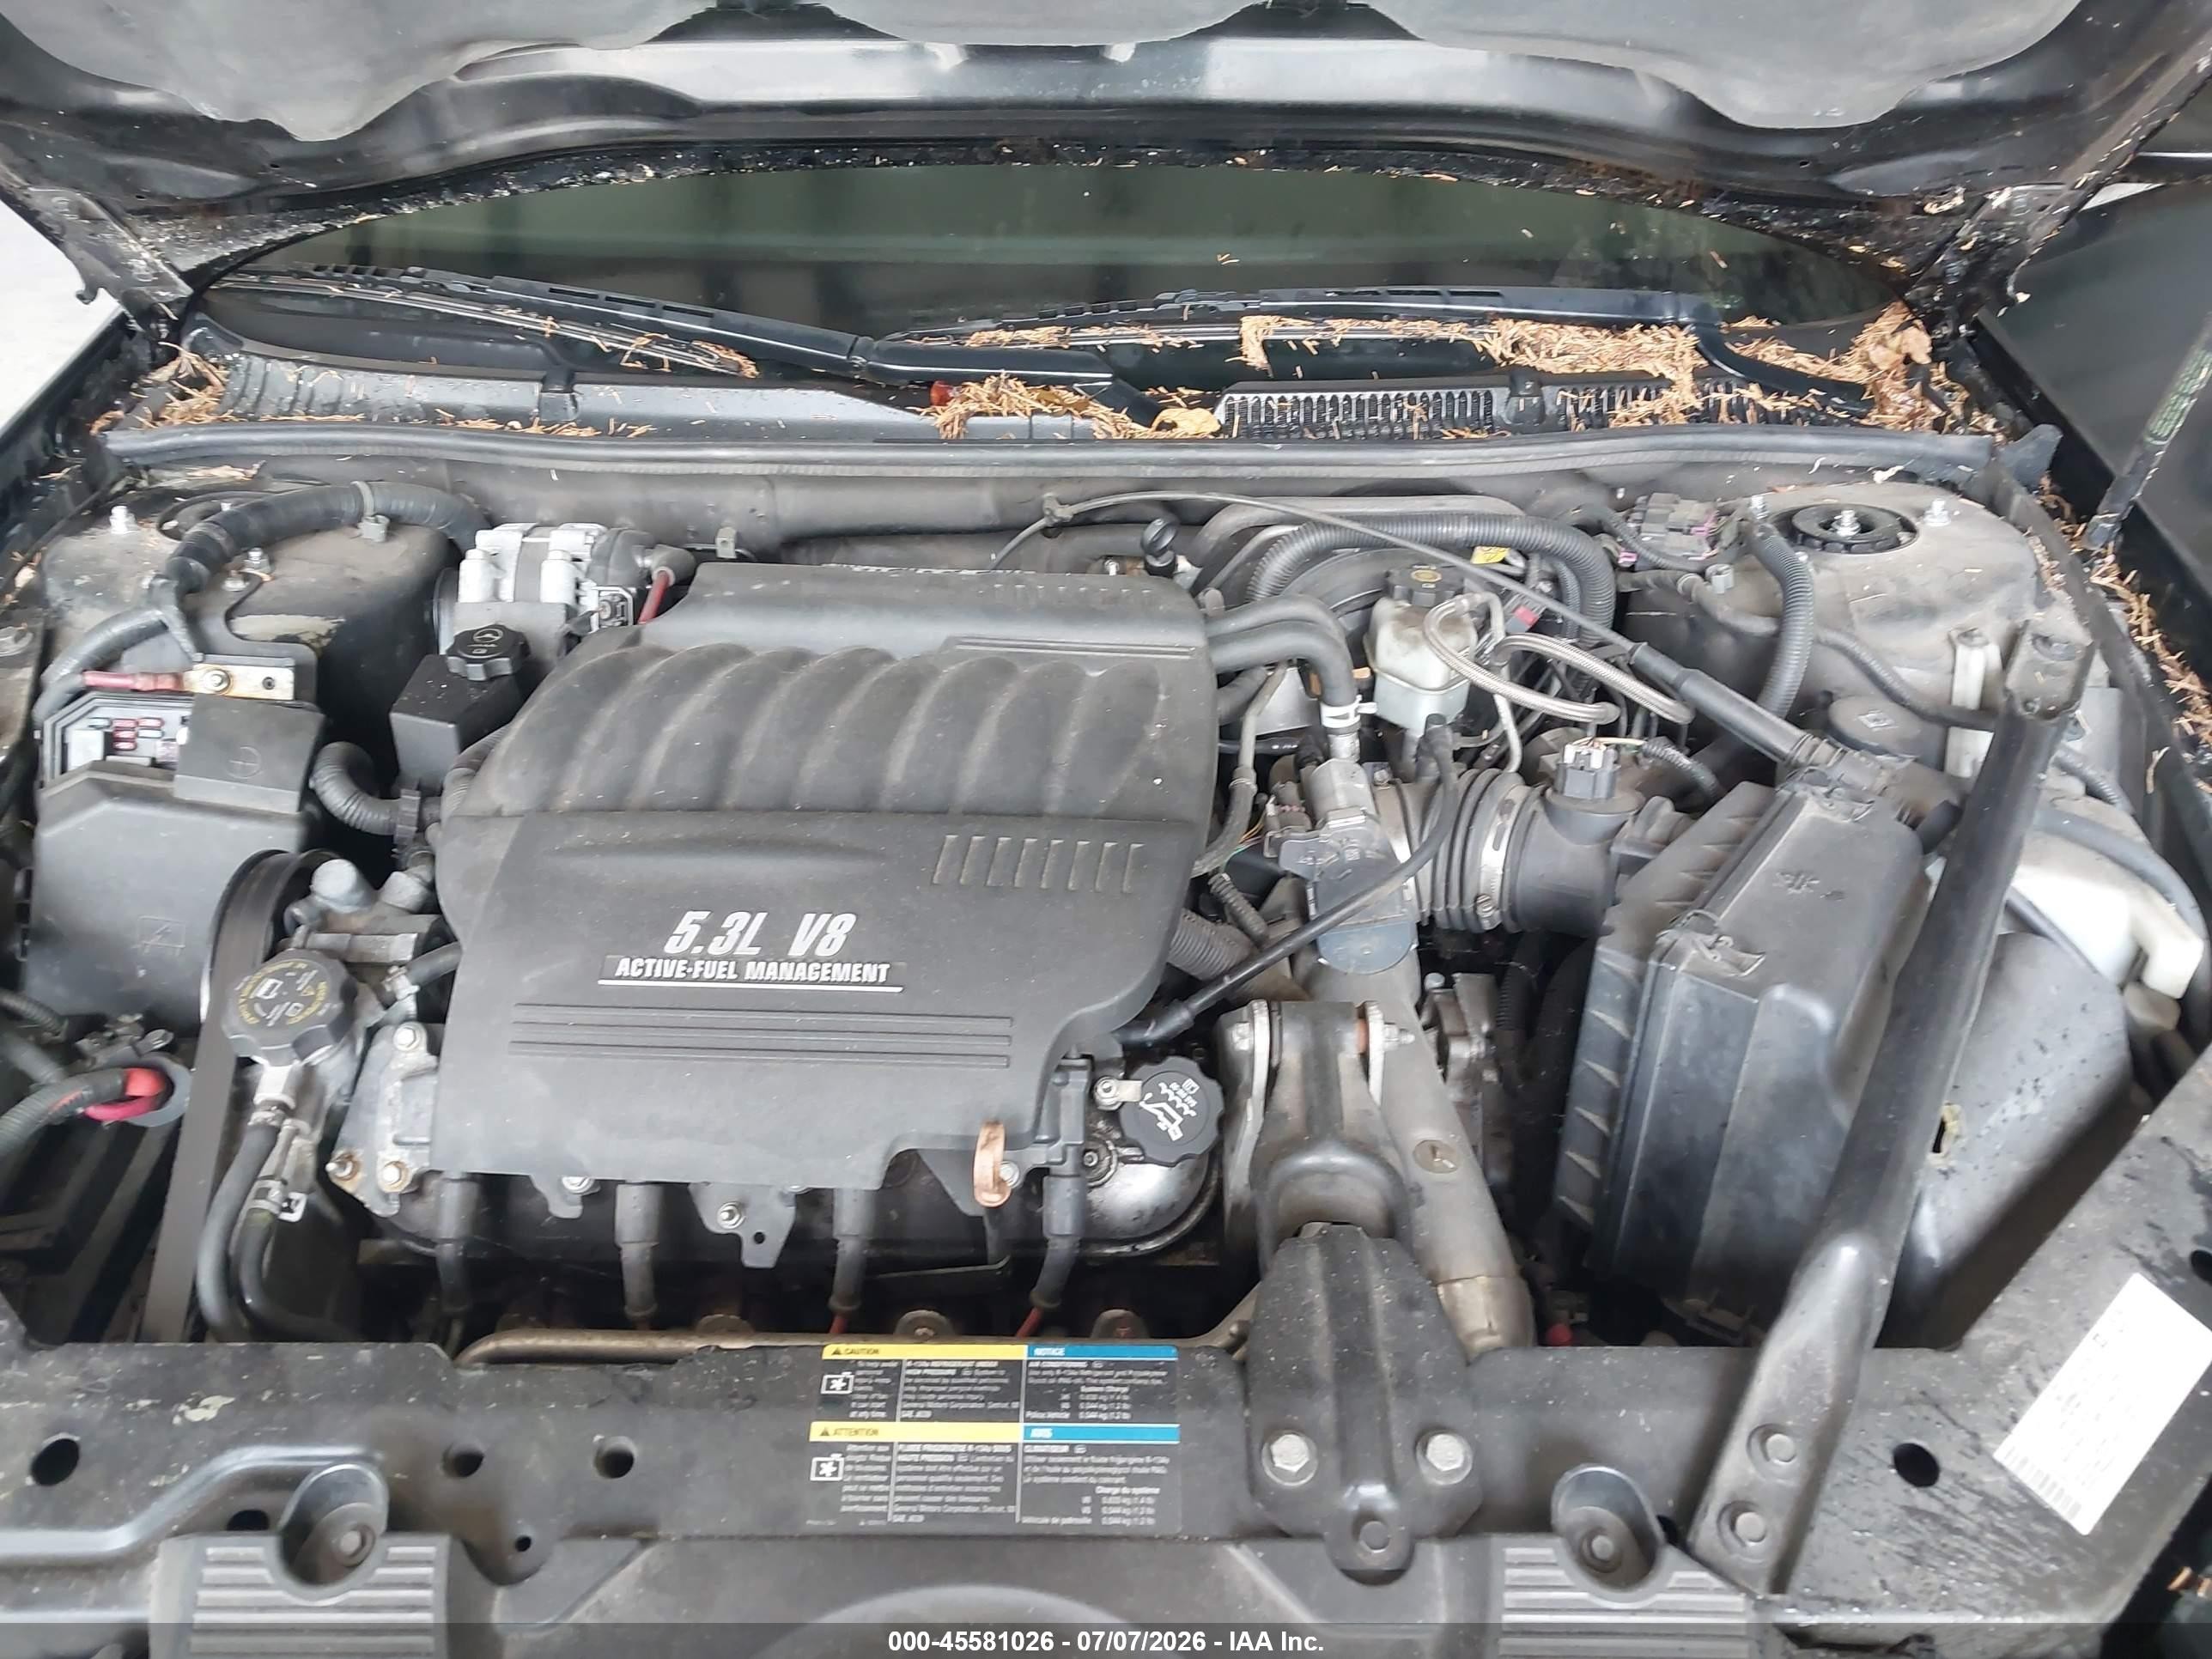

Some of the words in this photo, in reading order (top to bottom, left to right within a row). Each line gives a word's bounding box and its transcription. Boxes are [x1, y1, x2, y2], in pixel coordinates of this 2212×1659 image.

[664, 911, 768, 955] 5.3L
[788, 914, 857, 956] V8
[744, 962, 890, 982] MANAGEMENT
[833, 1427, 879, 1437] ATTENTION
